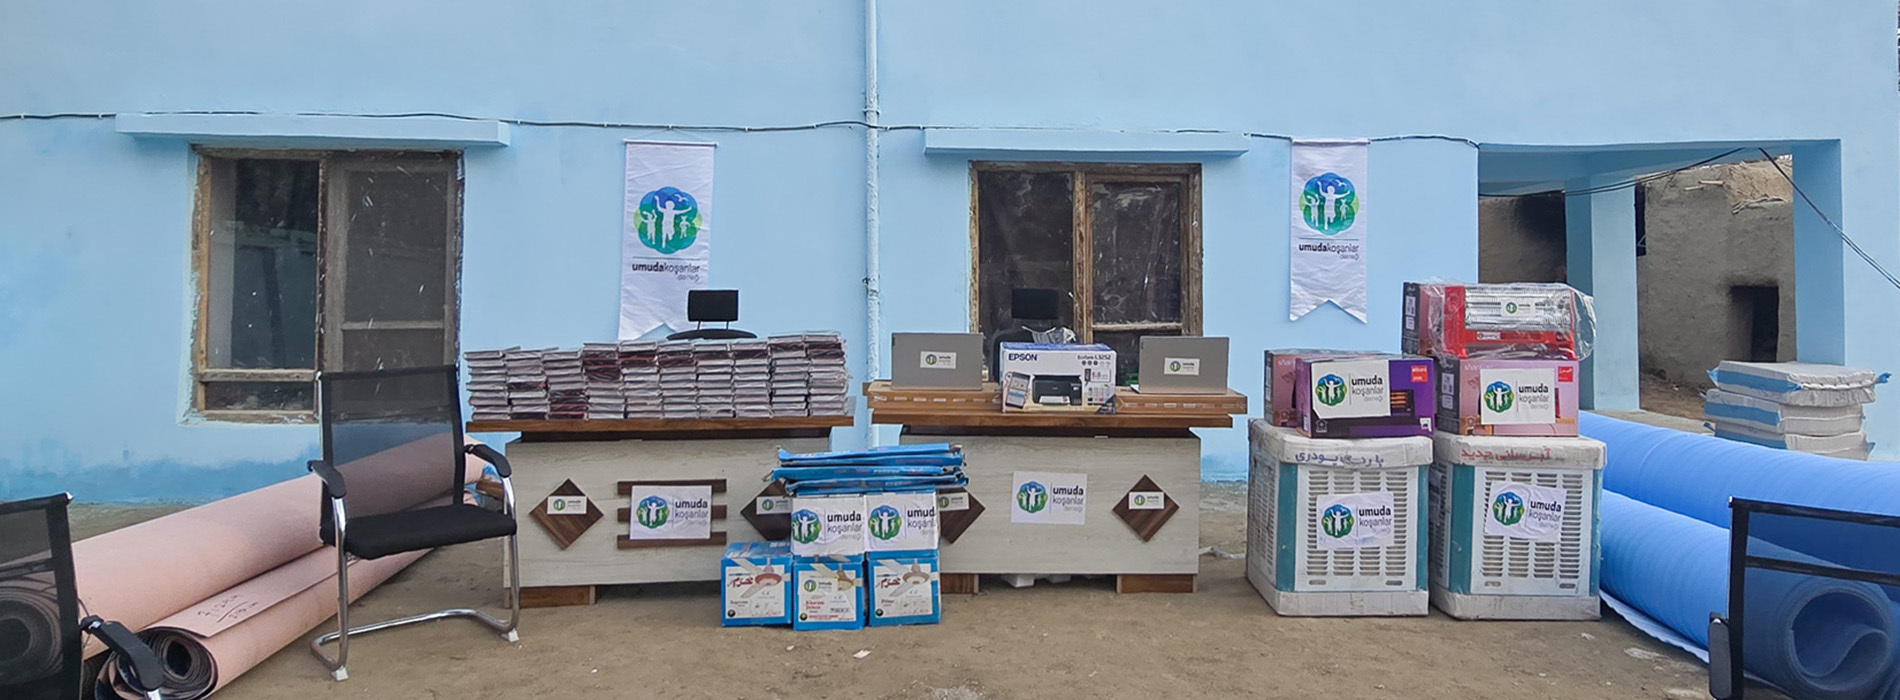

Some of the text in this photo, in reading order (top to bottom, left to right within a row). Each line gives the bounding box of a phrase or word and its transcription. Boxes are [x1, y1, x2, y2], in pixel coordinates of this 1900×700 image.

[632, 261, 700, 275] umudakoşanlar
[1008, 353, 1037, 361] EPSON
[1351, 375, 1383, 386] umuda
[1352, 386, 1384, 397] koşanlar
[1518, 383, 1549, 393] umuda
[1519, 394, 1550, 405] koşanlar
[1053, 485, 1084, 495] umuda
[674, 498, 708, 509] umuda
[1053, 495, 1084, 506] koşanlar
[1530, 500, 1562, 512] umuda
[675, 509, 709, 520] koşanlar
[827, 510, 862, 522] umuda
[907, 507, 936, 518] umud
[1359, 504, 1391, 517] umuda
[1529, 509, 1561, 521] koşanlar
[827, 522, 863, 534] koşanlar
[1359, 517, 1392, 529] koşanlar
